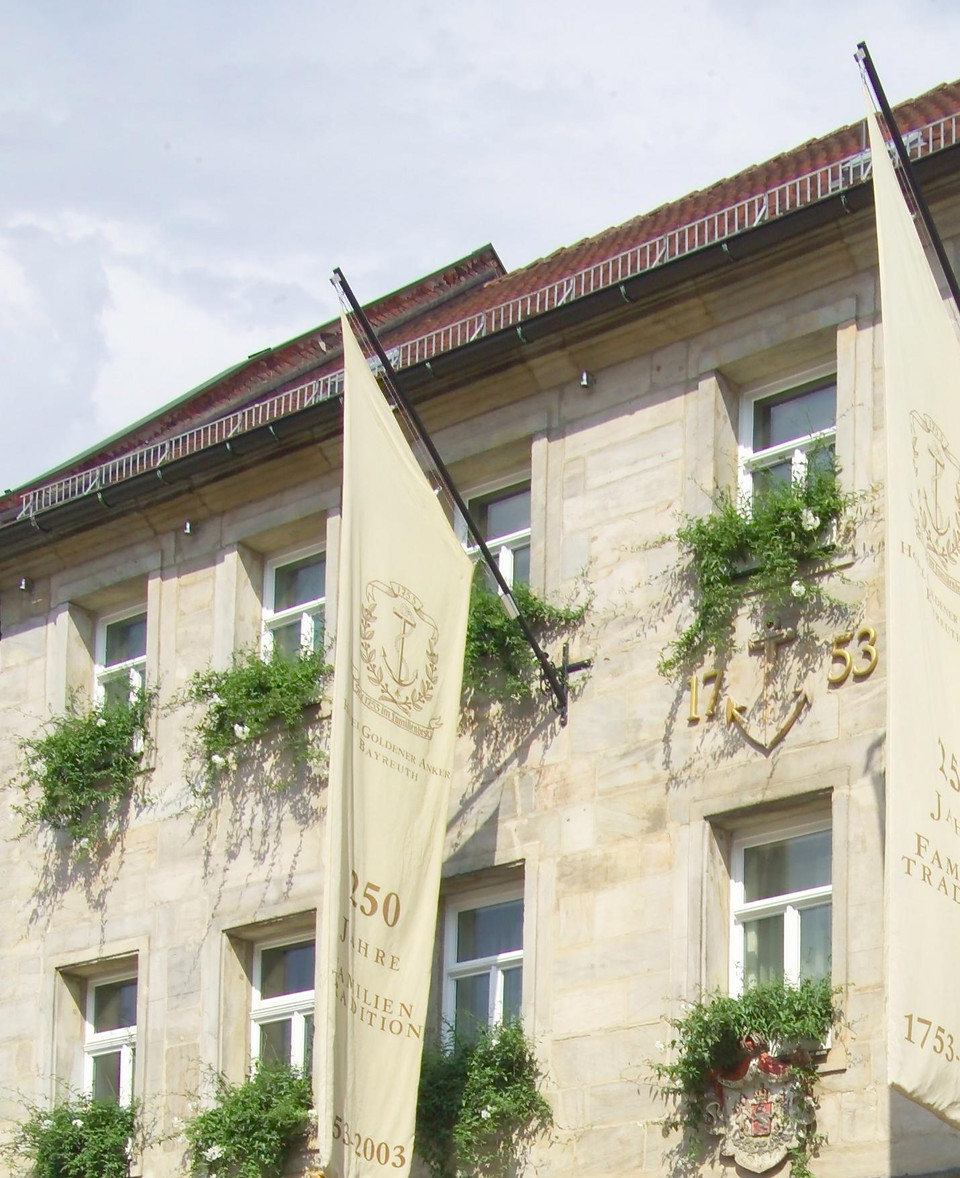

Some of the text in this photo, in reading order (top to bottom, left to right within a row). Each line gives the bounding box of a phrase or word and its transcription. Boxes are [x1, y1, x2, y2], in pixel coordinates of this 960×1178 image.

[687, 627, 878, 722] 17 53
[359, 737, 420, 782] BAYREUTH
[361, 724, 417, 765] GOLDENER
[419, 757, 451, 780] ANKER
[350, 869, 401, 928] 250
[332, 1114, 407, 1168] 53-2003
